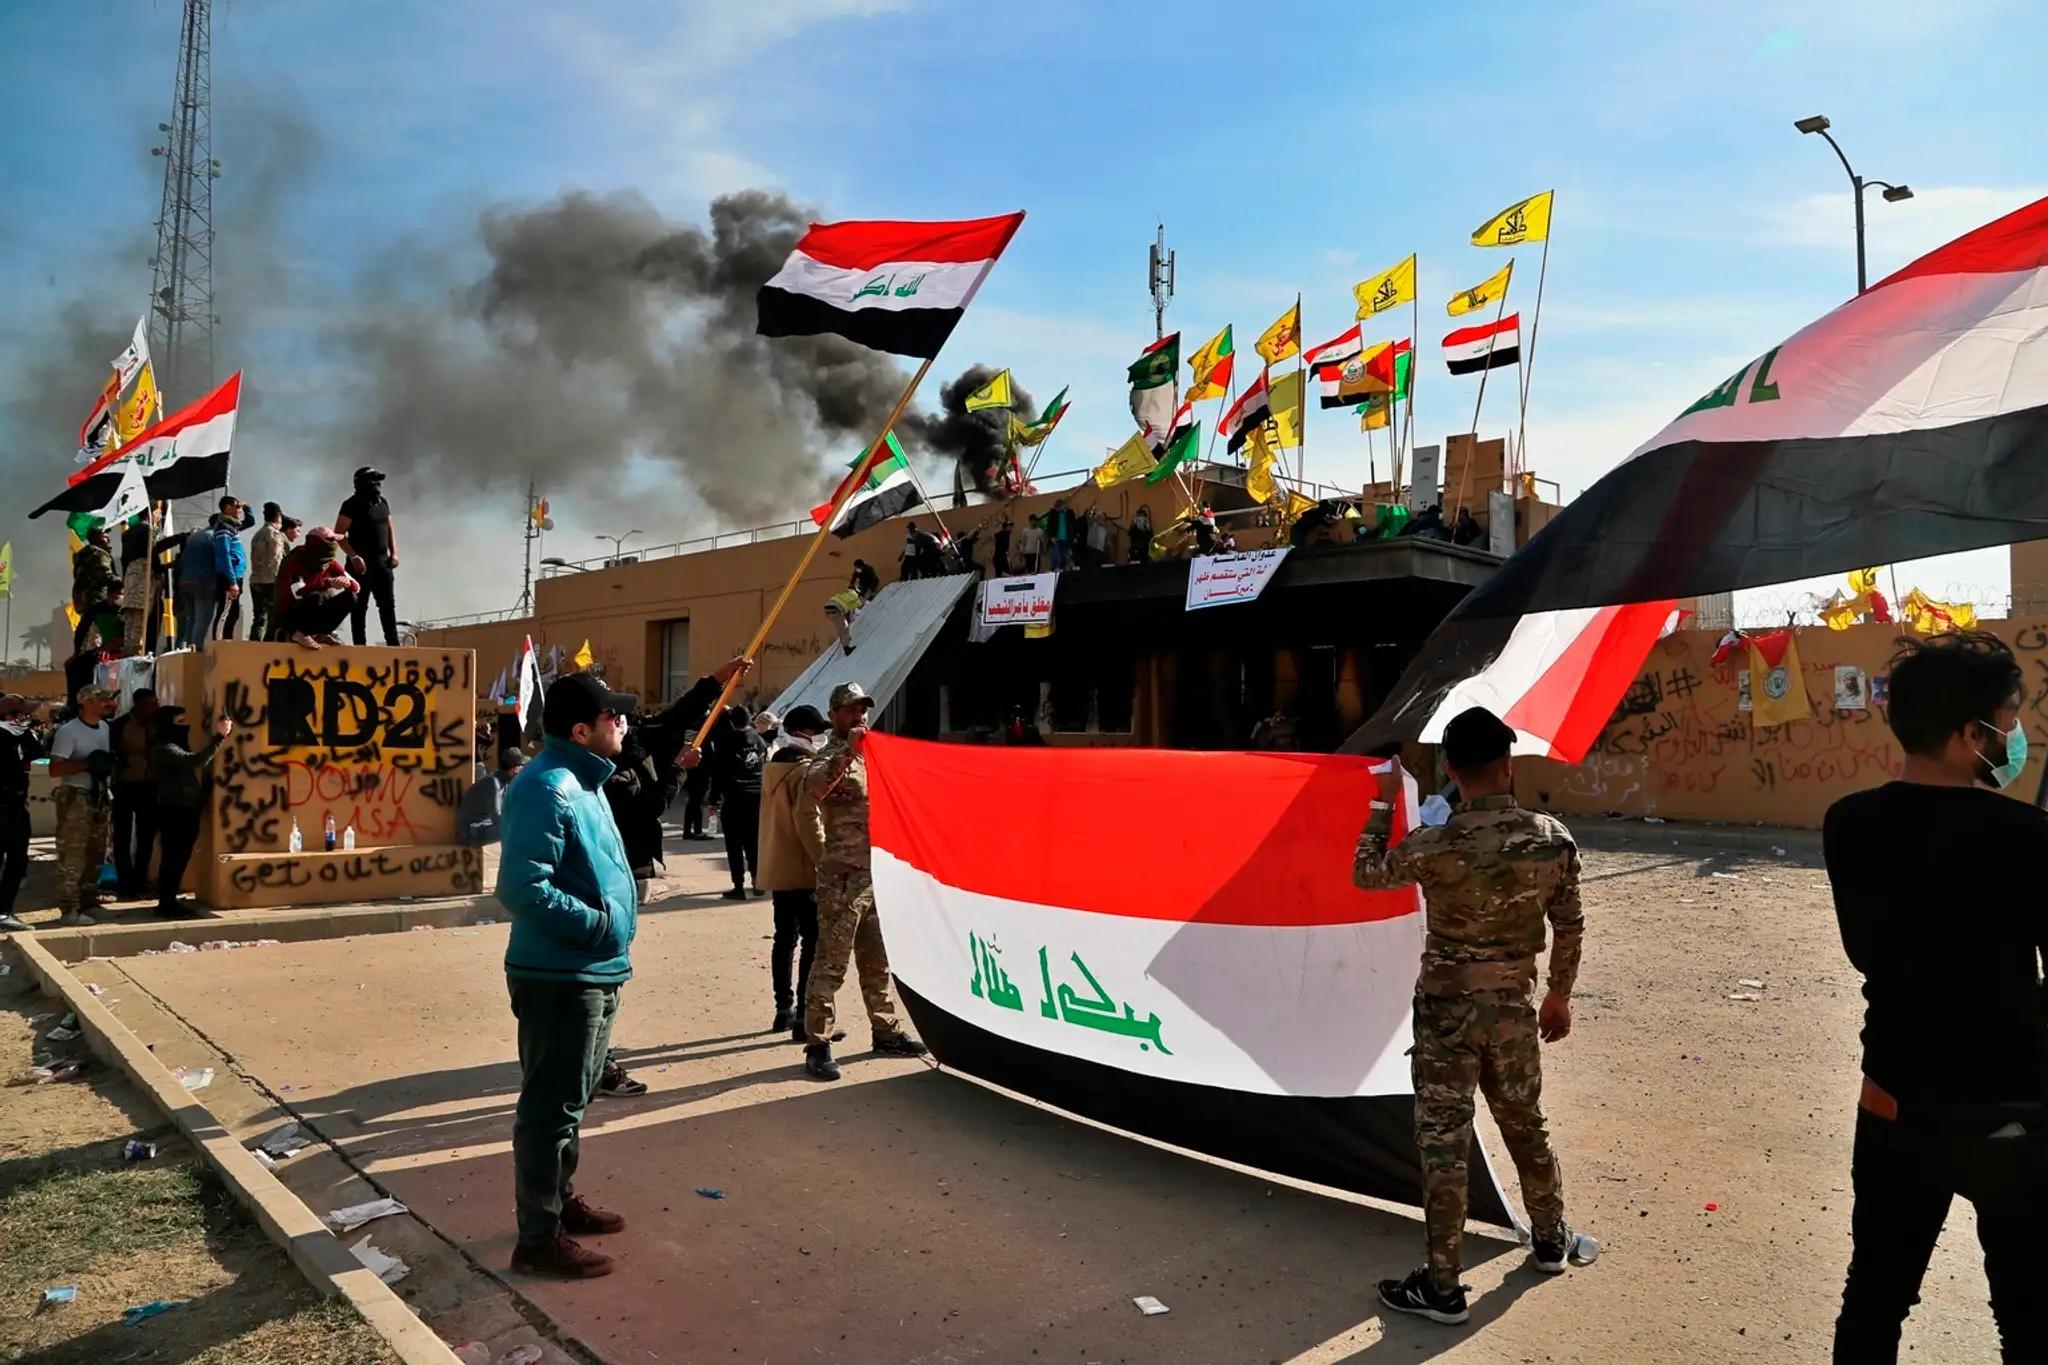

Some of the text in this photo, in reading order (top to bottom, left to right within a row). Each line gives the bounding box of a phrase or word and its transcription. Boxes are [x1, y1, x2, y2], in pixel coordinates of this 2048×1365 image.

[267, 678, 426, 748] RD2
[282, 760, 415, 807] DOWN
[231, 858, 312, 893] Get
[319, 853, 404, 882] out
